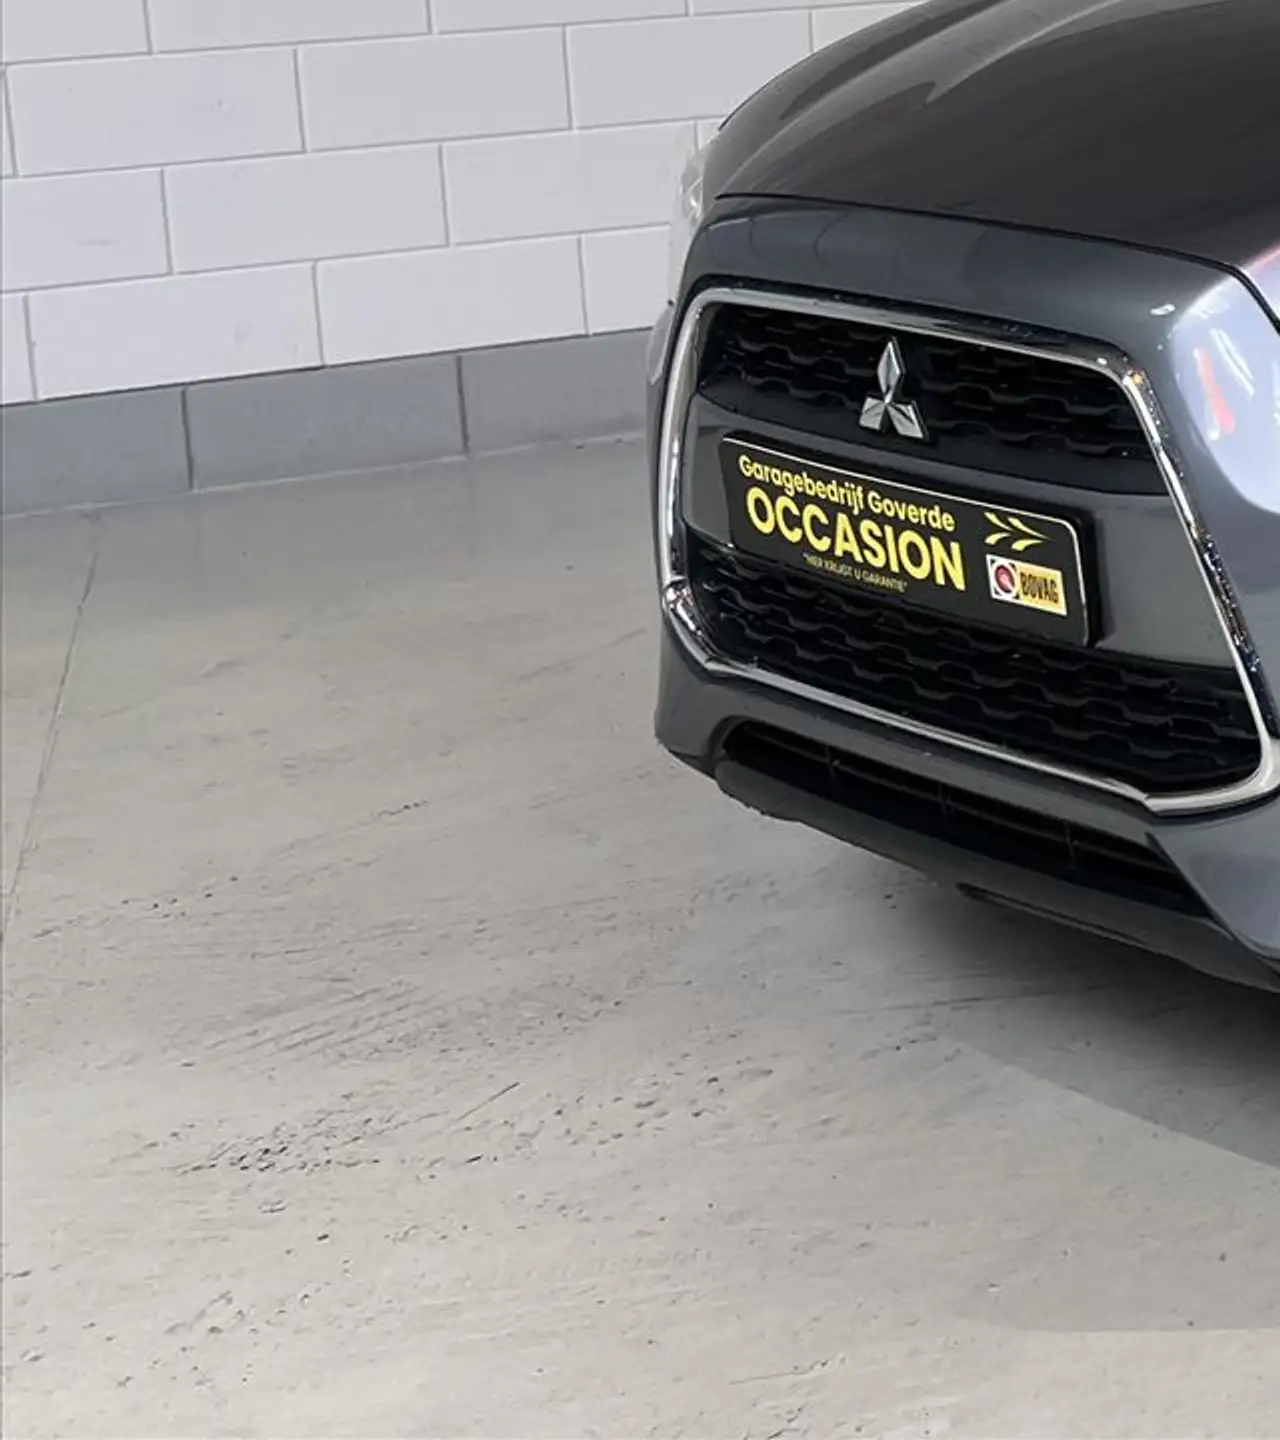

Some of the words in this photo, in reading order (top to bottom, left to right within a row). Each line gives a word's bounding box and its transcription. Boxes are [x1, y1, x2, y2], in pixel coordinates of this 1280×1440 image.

[738, 455, 863, 511] Garagebedrijf
[867, 491, 955, 532] Goverde
[746, 486, 966, 591] OCCASION
[1020, 571, 1059, 603] BOVAG
